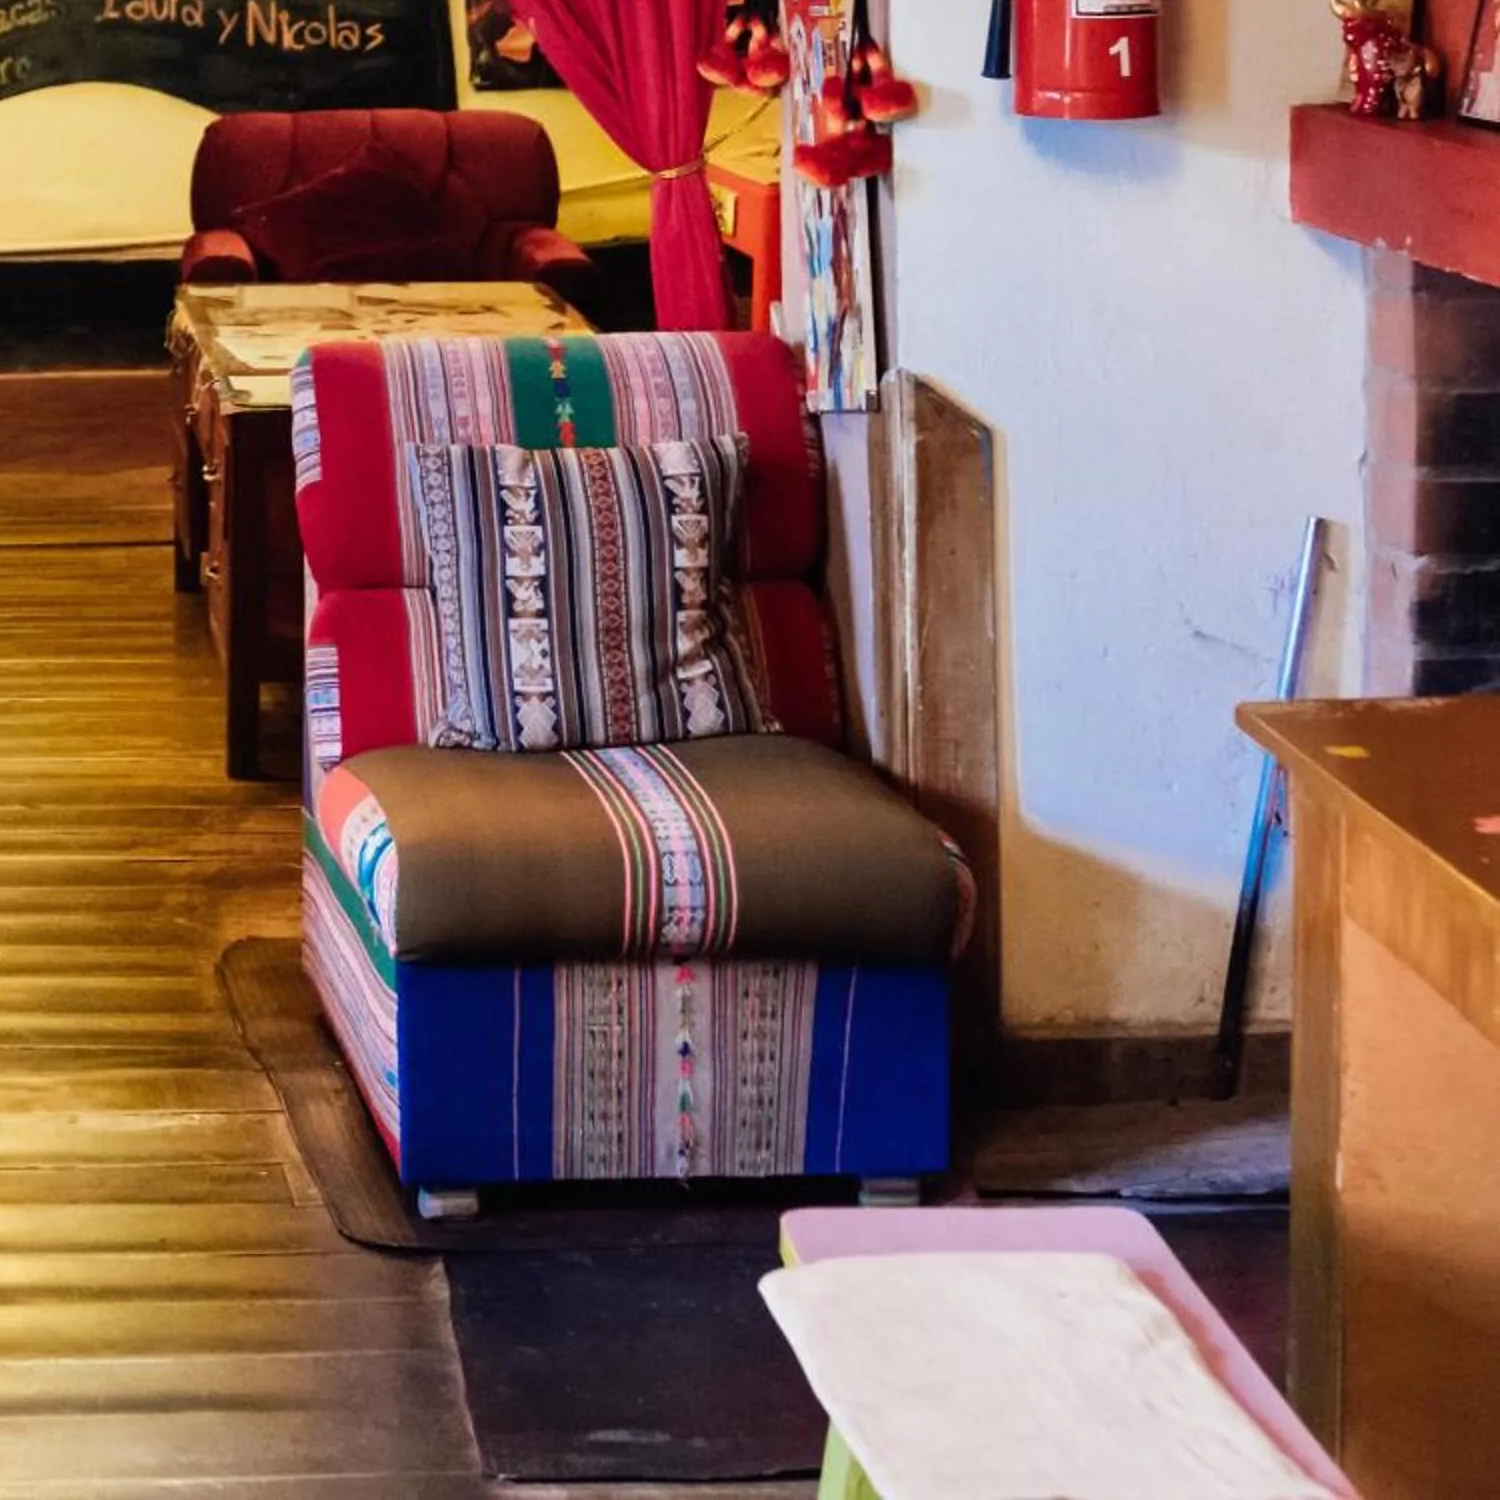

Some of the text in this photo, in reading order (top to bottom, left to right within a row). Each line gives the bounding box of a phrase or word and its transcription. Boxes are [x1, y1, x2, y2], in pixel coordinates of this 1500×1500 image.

[217, 8, 239, 45] y
[245, 0, 387, 51] Nicolas
[1109, 36, 1131, 77] 1
